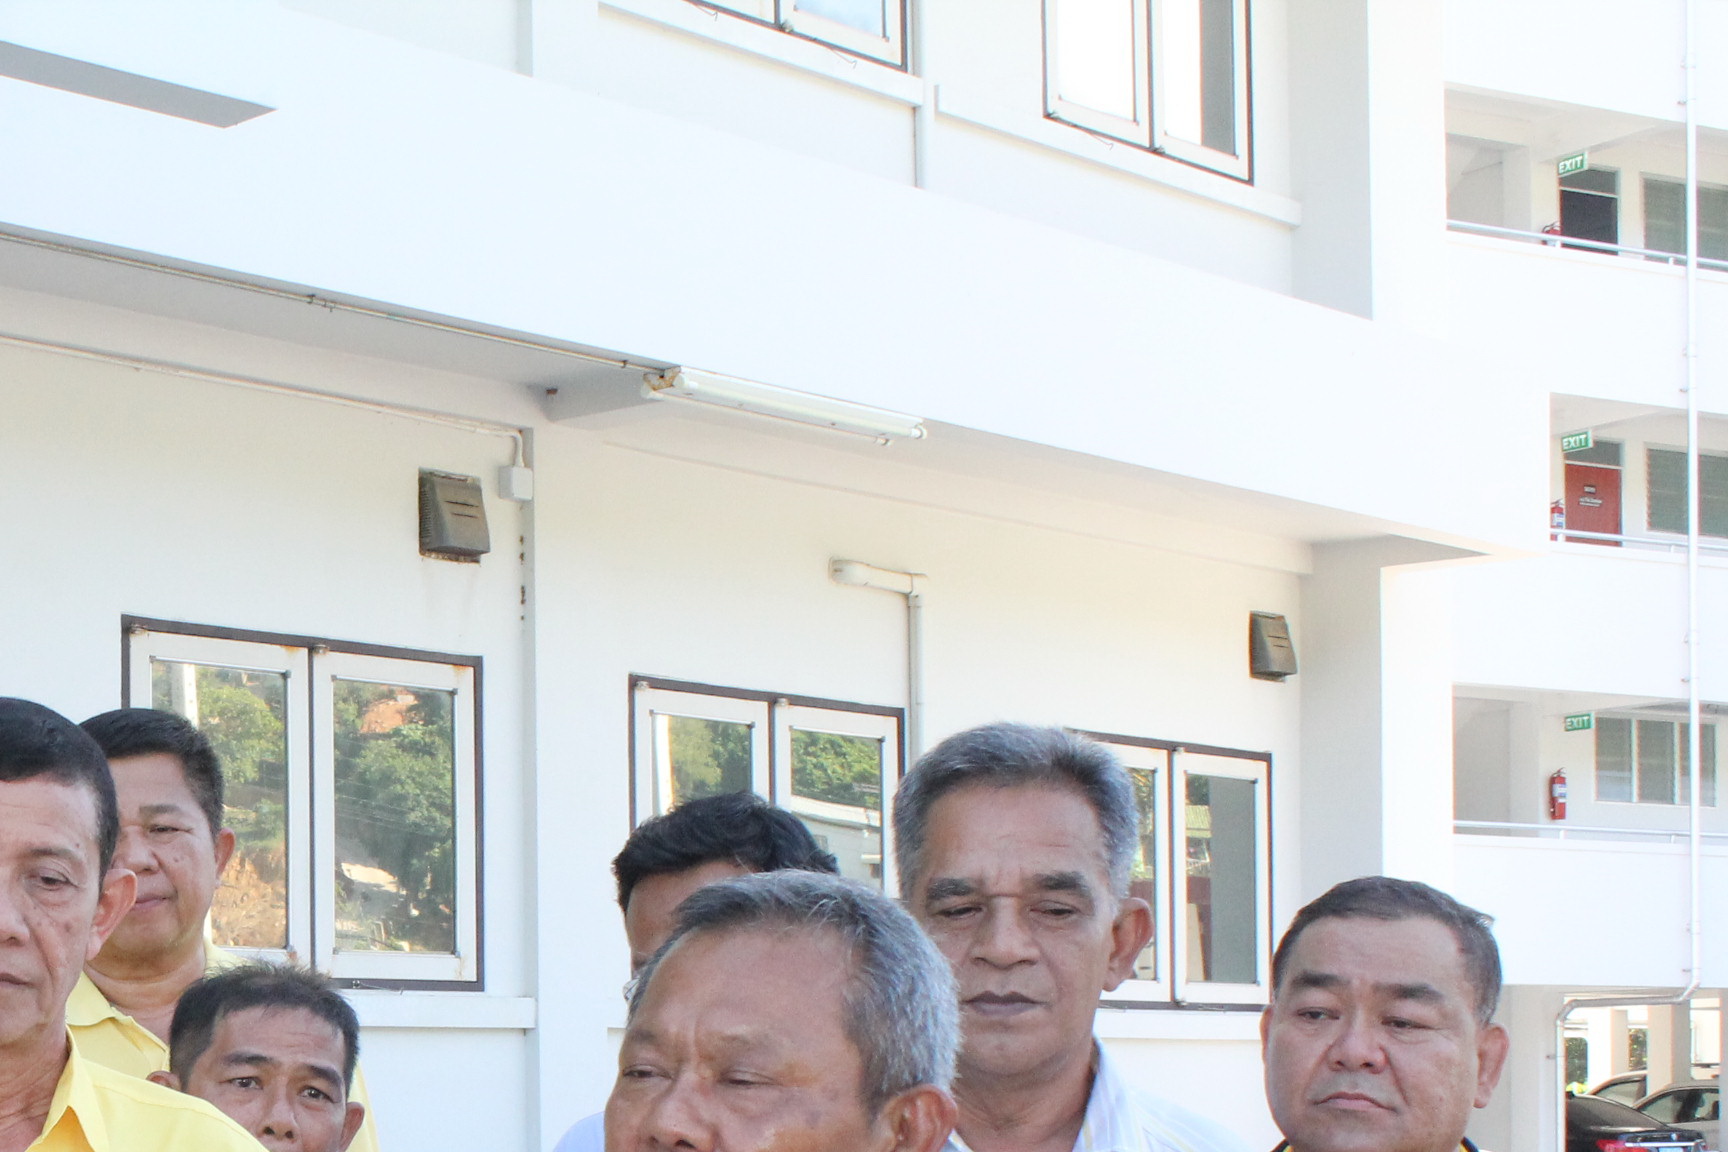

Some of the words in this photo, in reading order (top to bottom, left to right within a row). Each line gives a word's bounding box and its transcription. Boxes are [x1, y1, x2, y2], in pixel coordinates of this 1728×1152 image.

[1559, 156, 1583, 174] EXIT
[1563, 434, 1587, 449] EXIT
[1566, 716, 1590, 730] EXIT
